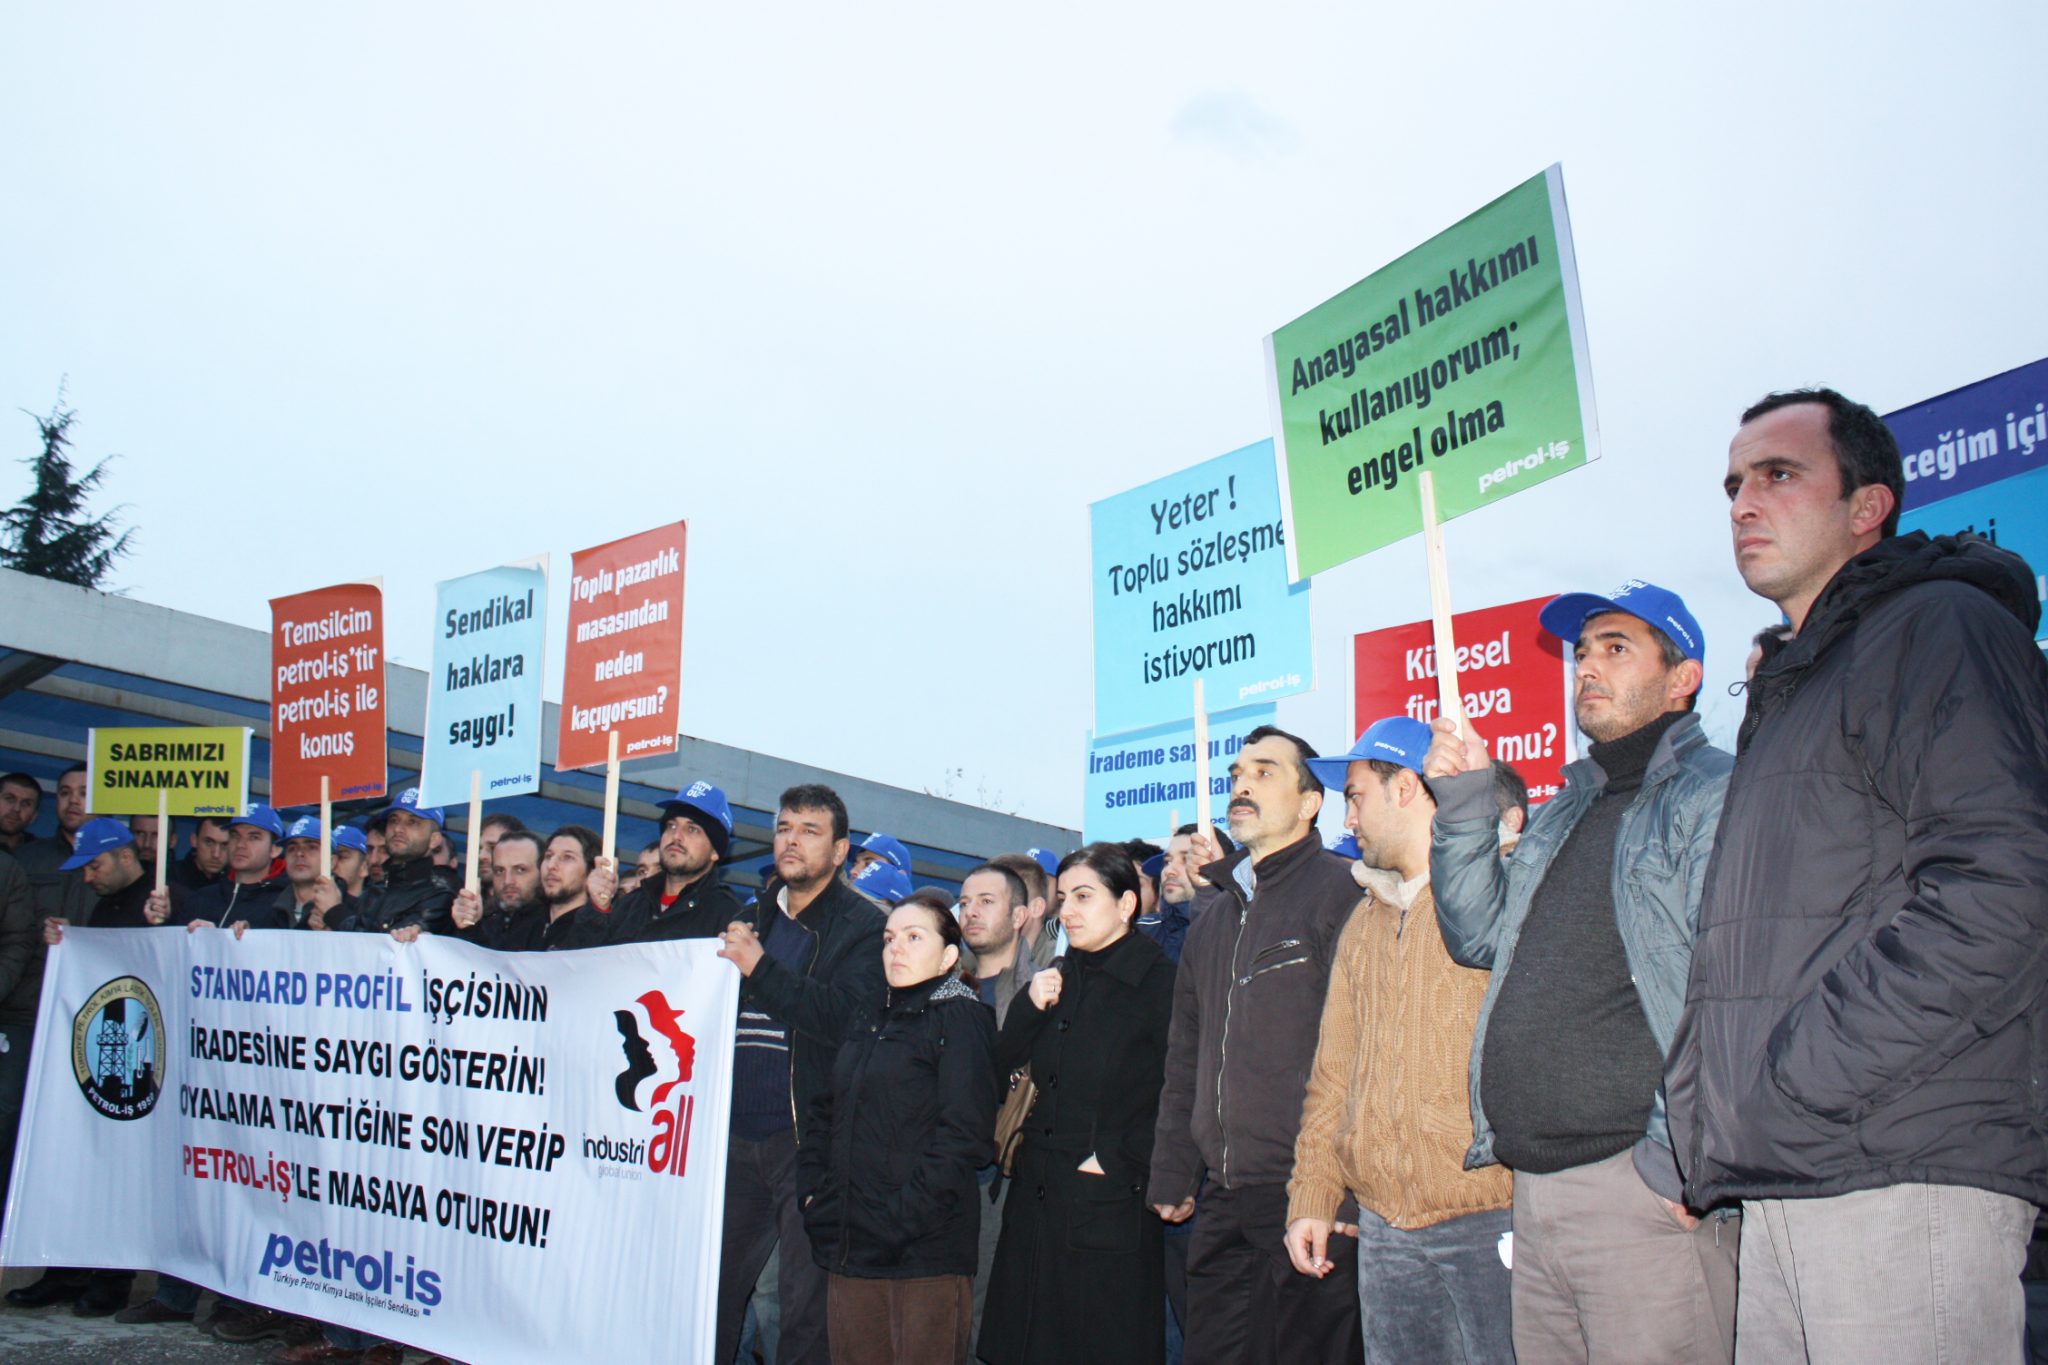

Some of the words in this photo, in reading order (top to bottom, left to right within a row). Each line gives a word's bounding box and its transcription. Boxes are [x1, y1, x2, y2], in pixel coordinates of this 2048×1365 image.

[1291, 298, 1410, 396] Anayasal
[1415, 234, 1539, 328] hakkımı
[1319, 320, 1520, 446] kullanıyorum;
[1347, 426, 1424, 496] engel
[1430, 399, 1505, 458] olma
[2006, 402, 2048, 456] içi
[1478, 438, 1570, 494] petrol-iş
[1151, 488, 1219, 535] Yeter
[572, 569, 613, 604] Toplu
[615, 547, 679, 595] pazarlık
[1109, 553, 1169, 596] Toplu
[1177, 519, 1284, 576] sözleşme
[281, 607, 372, 647] Temsilcim
[445, 588, 534, 639] Sendikal
[576, 599, 668, 643] masasından
[1153, 584, 1242, 632] hakkımı
[277, 644, 378, 692] petrol-iş'tir
[446, 653, 524, 692] haklara
[595, 650, 643, 682] neden
[1144, 632, 1256, 684] istiyorum
[1406, 630, 1510, 681] Küesel
[278, 689, 350, 732] petrol-iş
[355, 683, 378, 712] ile
[571, 685, 668, 734] kaçıyorsun?
[1239, 673, 1301, 699] petrol-iş
[1405, 687, 1511, 724] firaya
[300, 731, 355, 760] konuş
[449, 703, 515, 748] saygı!
[627, 735, 673, 753] petrol-iş
[1497, 722, 1557, 762] mu?
[110, 743, 224, 761] SABRIMIZI
[1089, 748, 1165, 774] İrademe
[104, 769, 229, 788] SINAMAYIN
[490, 773, 532, 789] petrol-iş
[191, 965, 307, 1005] STANDARD
[315, 967, 411, 1012] PROFİL
[190, 1018, 306, 1070] İRADESİNE
[314, 1037, 392, 1078] SAYGI
[399, 1039, 545, 1095] GÖSTERİN!
[180, 1084, 276, 1129] OYALAMA
[280, 1097, 413, 1150] TAKTİĞİNE
[420, 1116, 468, 1159] SON
[477, 1122, 566, 1172] VERİP
[183, 1144, 321, 1203] PETROL-İŞ'LE
[329, 1170, 428, 1222] MASAYA
[436, 1189, 551, 1248] OTURUN!
[598, 1165, 621, 1179] global
[621, 1168, 642, 1180] union
[259, 1233, 442, 1316] petrol-iş
[273, 1270, 299, 1287] Türkiye
[300, 1277, 321, 1291] Petrol
[322, 1281, 343, 1298] Kimya
[344, 1288, 364, 1303] Lastik
[387, 1300, 420, 1317] Sendikası
